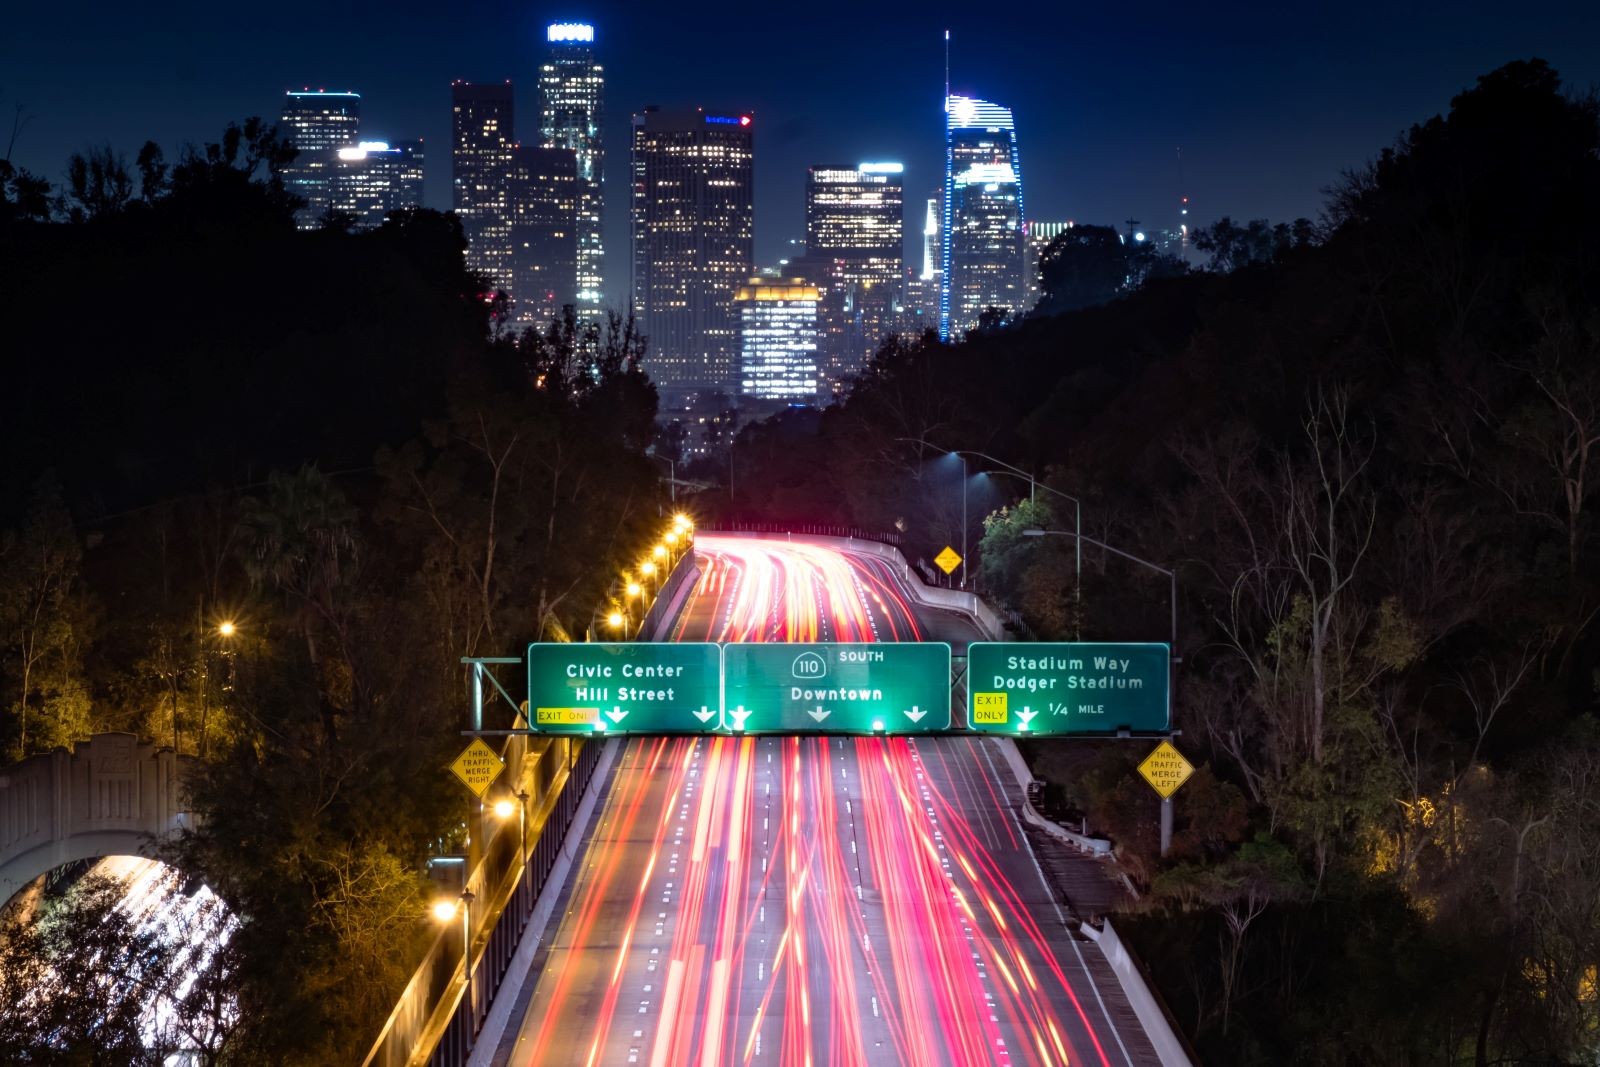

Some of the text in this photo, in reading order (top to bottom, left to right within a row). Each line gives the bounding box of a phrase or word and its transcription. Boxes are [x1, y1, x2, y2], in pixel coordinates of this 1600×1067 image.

[839, 651, 884, 662] SOUTH
[566, 663, 683, 678] Civic Center
[799, 660, 819, 673] 110
[1007, 656, 1130, 673] Stadium Way
[993, 675, 1143, 693] Dodger Stadium
[576, 687, 675, 701] Hill Street
[791, 687, 882, 701] Downtown
[977, 696, 1005, 705] EXIT
[976, 711, 1004, 720] ONLY
[1078, 704, 1104, 714] MILE
[538, 711, 562, 721] EXIT
